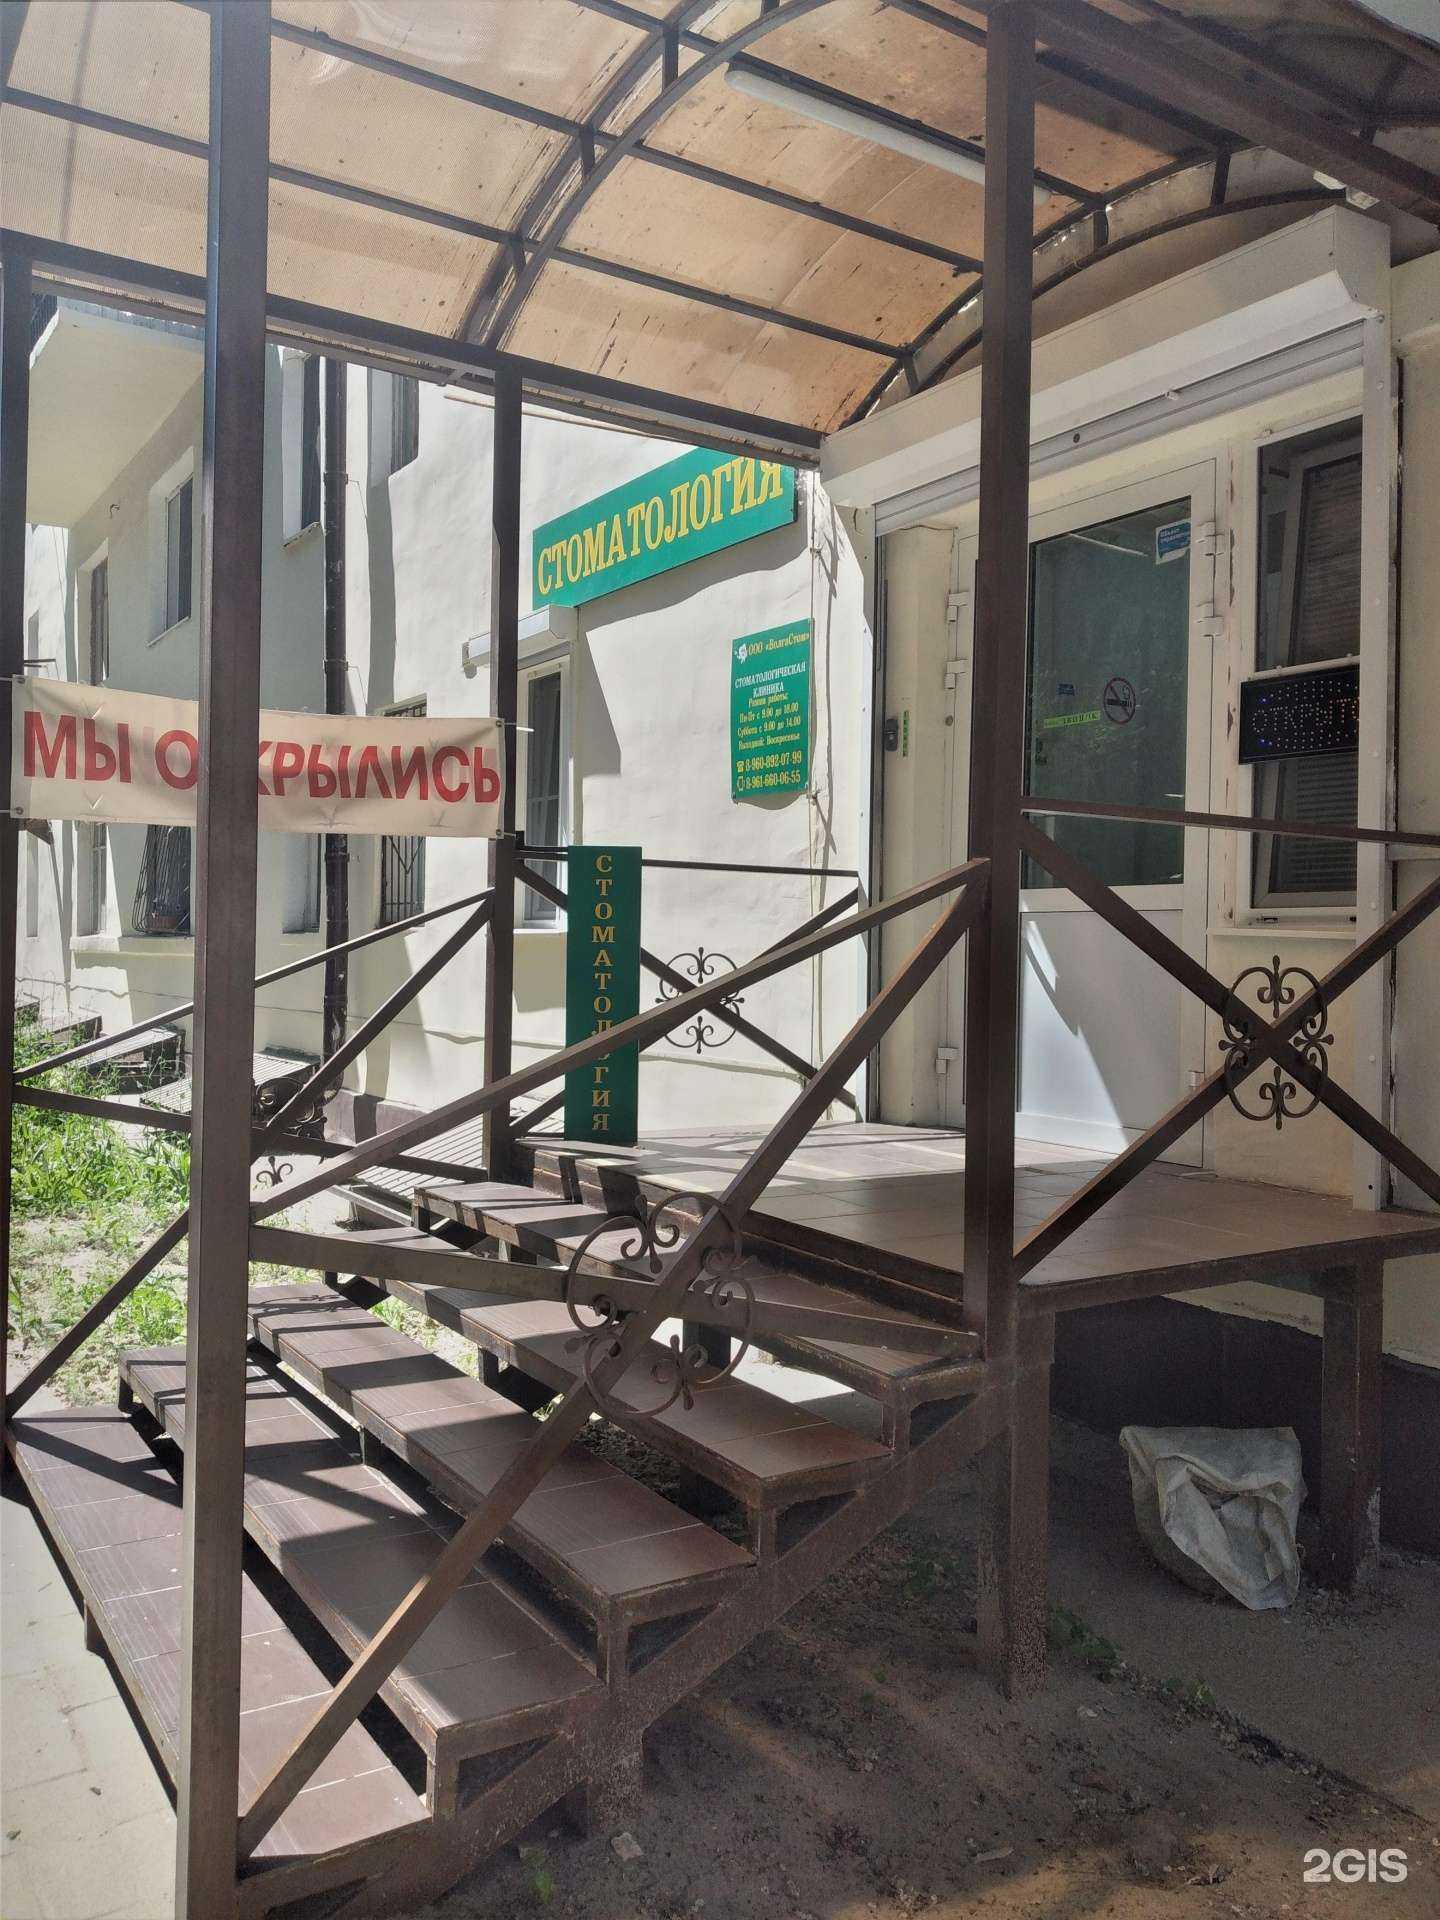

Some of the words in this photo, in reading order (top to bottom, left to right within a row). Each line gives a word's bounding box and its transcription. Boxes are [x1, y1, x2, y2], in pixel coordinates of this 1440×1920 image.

[537, 456, 783, 596] СТОМАТОЛОГИЯ
[748, 641, 763, 656] ООО
[735, 660, 806, 689] СТОМАТОЛОГИЧЕСКАЯ
[753, 681, 784, 698] КЛИНИКА
[786, 715, 801, 728] 14.00
[23, 710, 132, 784] МЫ
[155, 729, 501, 803] ОРЫЛИСЬ
[591, 854, 616, 1131] СТОМАТОЛГИЯ
